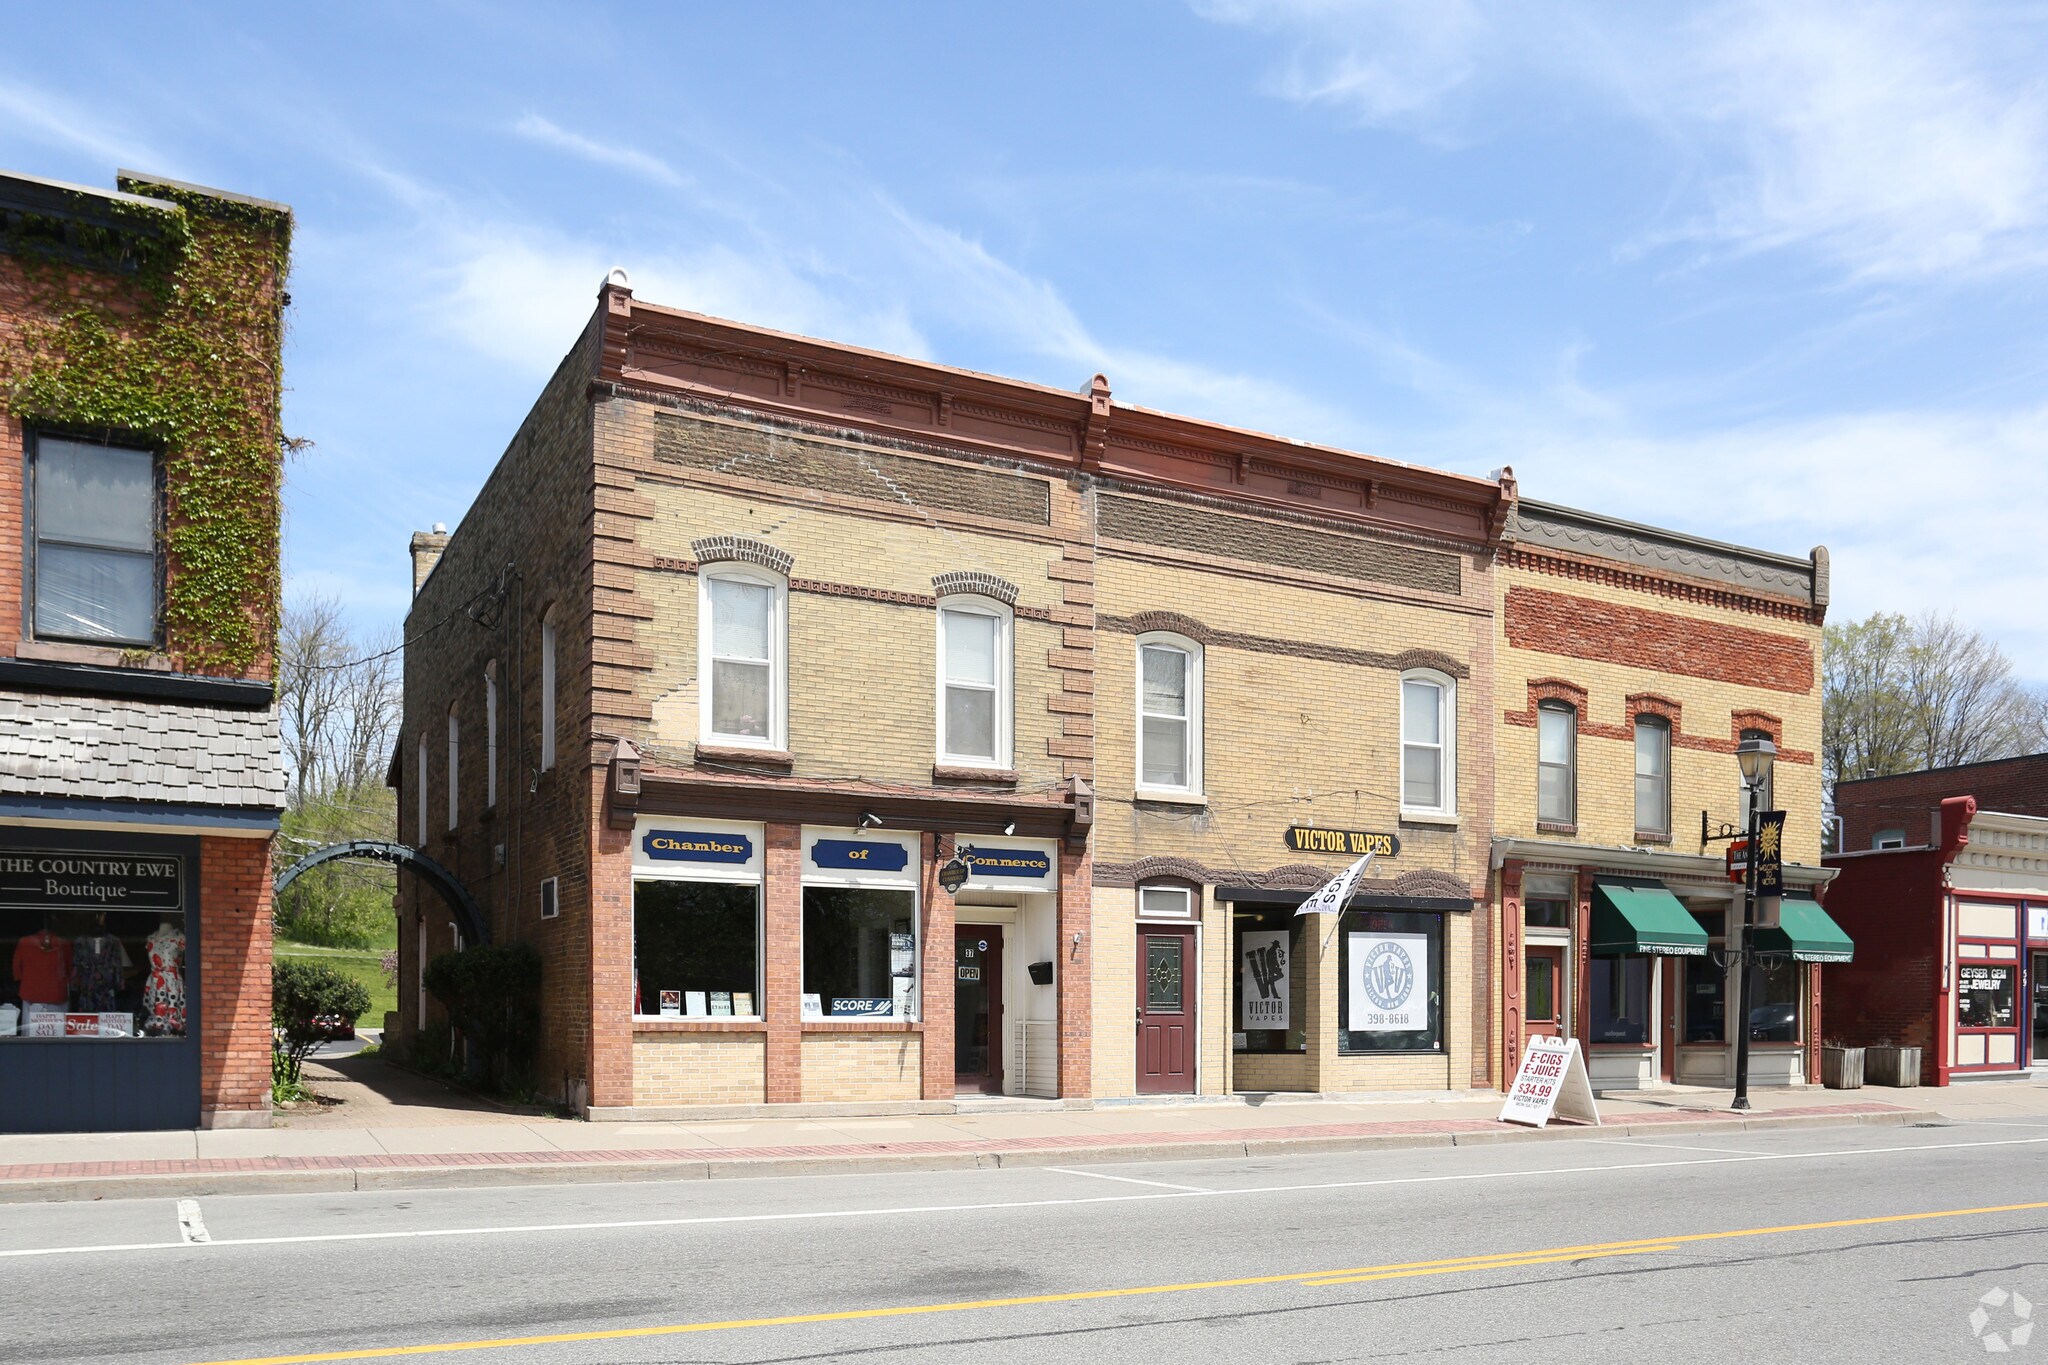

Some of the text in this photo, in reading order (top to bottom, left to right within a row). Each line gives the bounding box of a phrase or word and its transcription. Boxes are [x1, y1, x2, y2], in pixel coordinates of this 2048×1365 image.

[651, 838, 744, 853] Chamber
[1295, 829, 1392, 855] VICTOR VAPES
[848, 849, 869, 860] of
[0, 858, 176, 877] THE COUNTRY EWE
[963, 855, 1046, 868] Commerce
[45, 879, 127, 901] Boutique
[1365, 943, 1412, 968] VICTOR VAPES
[1653, 946, 1673, 954] STEREO
[1675, 947, 1705, 955] EQUIPMENT
[960, 968, 979, 978] OPEN
[1960, 968, 2006, 979] GEYSER GEM
[1971, 979, 2001, 990] JEWELRY
[833, 1000, 873, 1010] SCORE
[1249, 1001, 1283, 1014] VICTOR
[1387, 1001, 1400, 1009] NEW
[1368, 1013, 1409, 1024] 398-8618
[66, 1019, 98, 1031] Sale
[1530, 1052, 1563, 1066] E-CIGS
[1524, 1063, 1562, 1077] E-JUICE
[1520, 1075, 1557, 1086] STARTER KITS
[1518, 1083, 1552, 1098] $34.99
[1513, 1095, 1549, 1105] VICTOR VAPES
